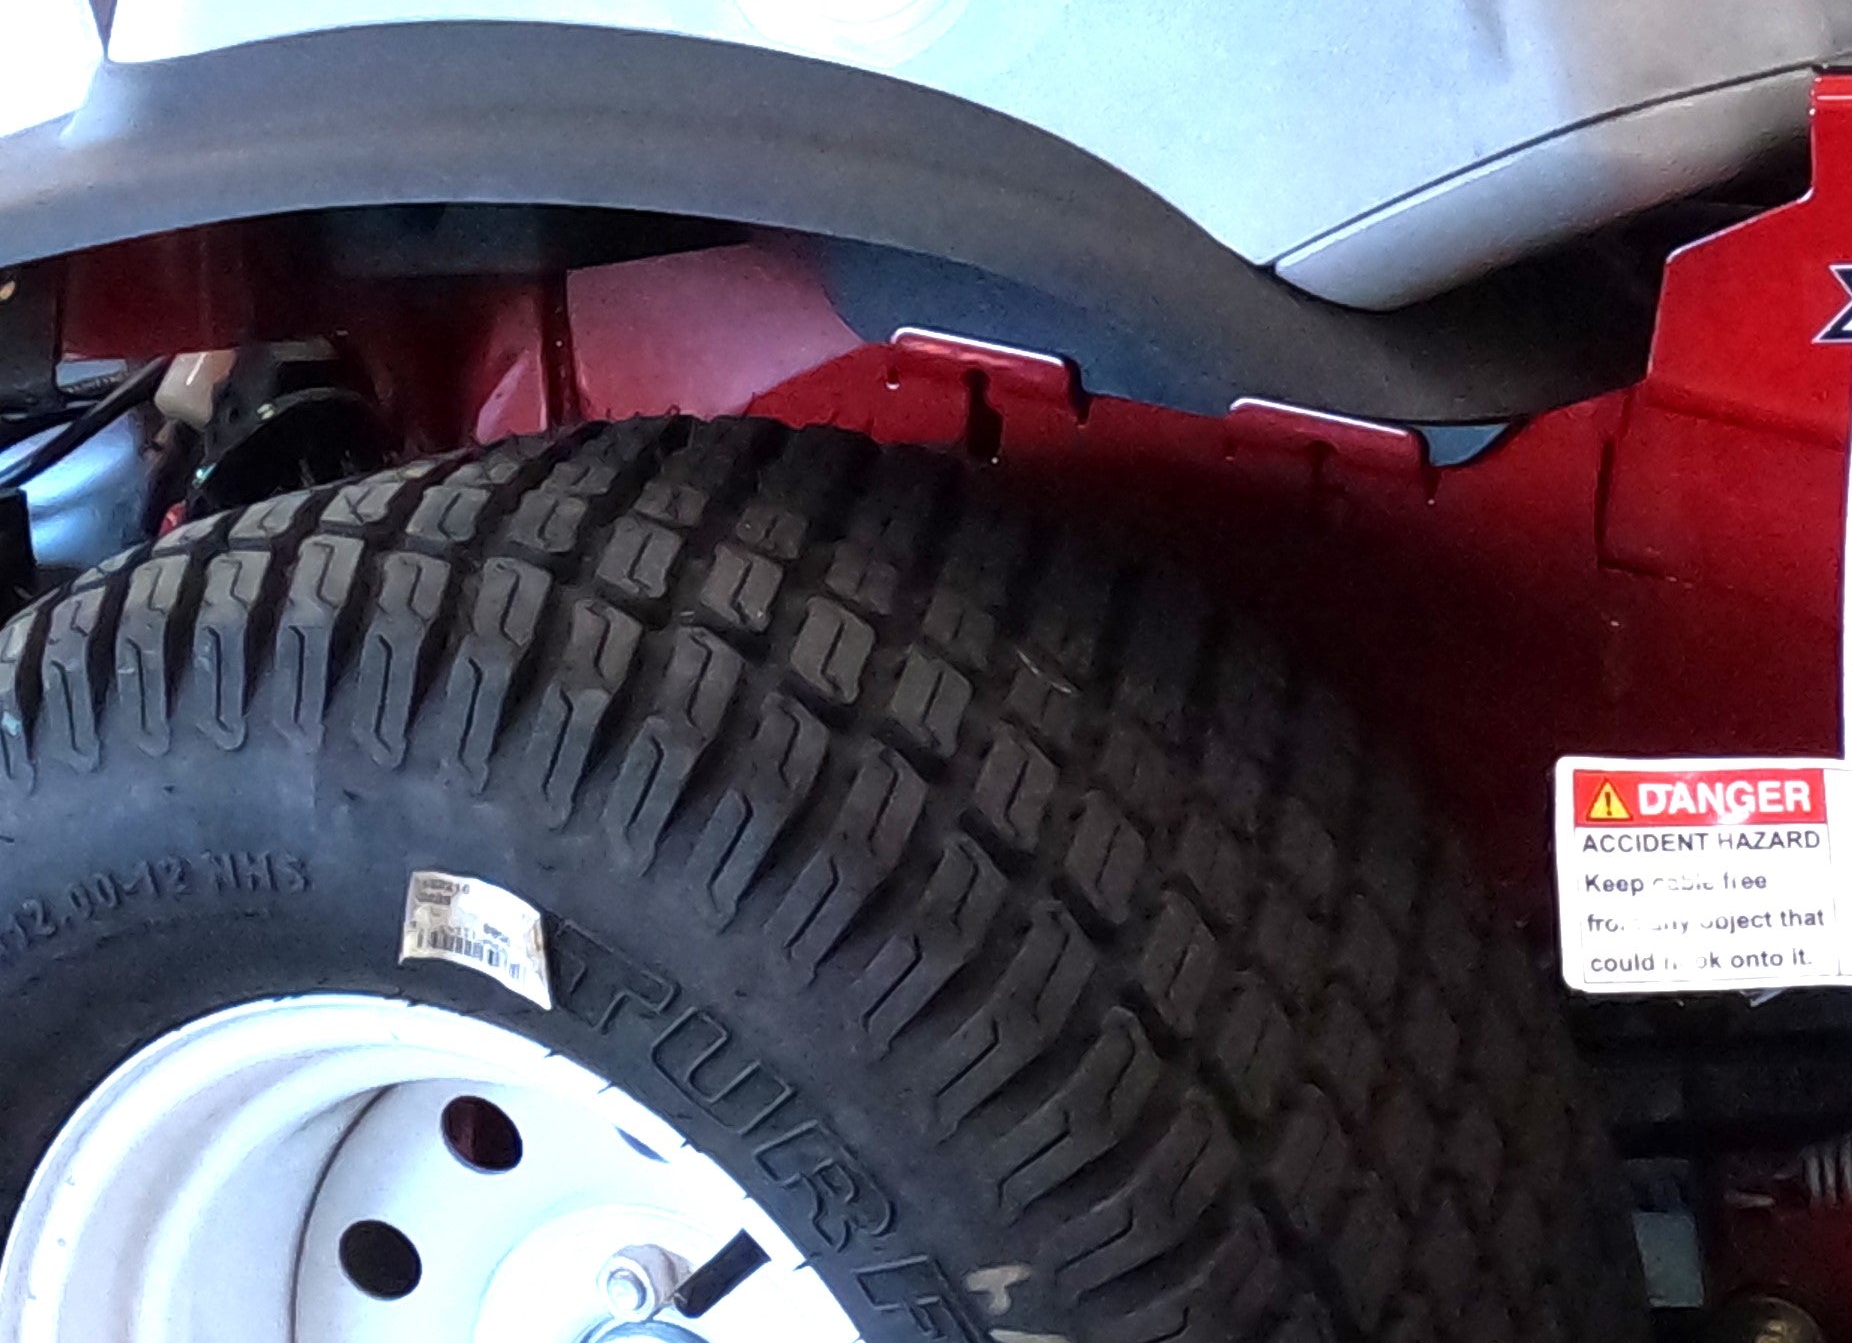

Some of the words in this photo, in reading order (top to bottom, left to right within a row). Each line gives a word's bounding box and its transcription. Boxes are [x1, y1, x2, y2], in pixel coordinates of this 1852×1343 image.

[1637, 779, 1812, 818] DANGER
[1582, 831, 1710, 854] ACCIDENT
[1718, 829, 1820, 850] HAZARD
[1585, 873, 1645, 896] Keep
[1587, 913, 1638, 933] fro
[1779, 908, 1825, 928] that
[1590, 953, 1655, 973] could
[1730, 950, 1784, 969] onto
